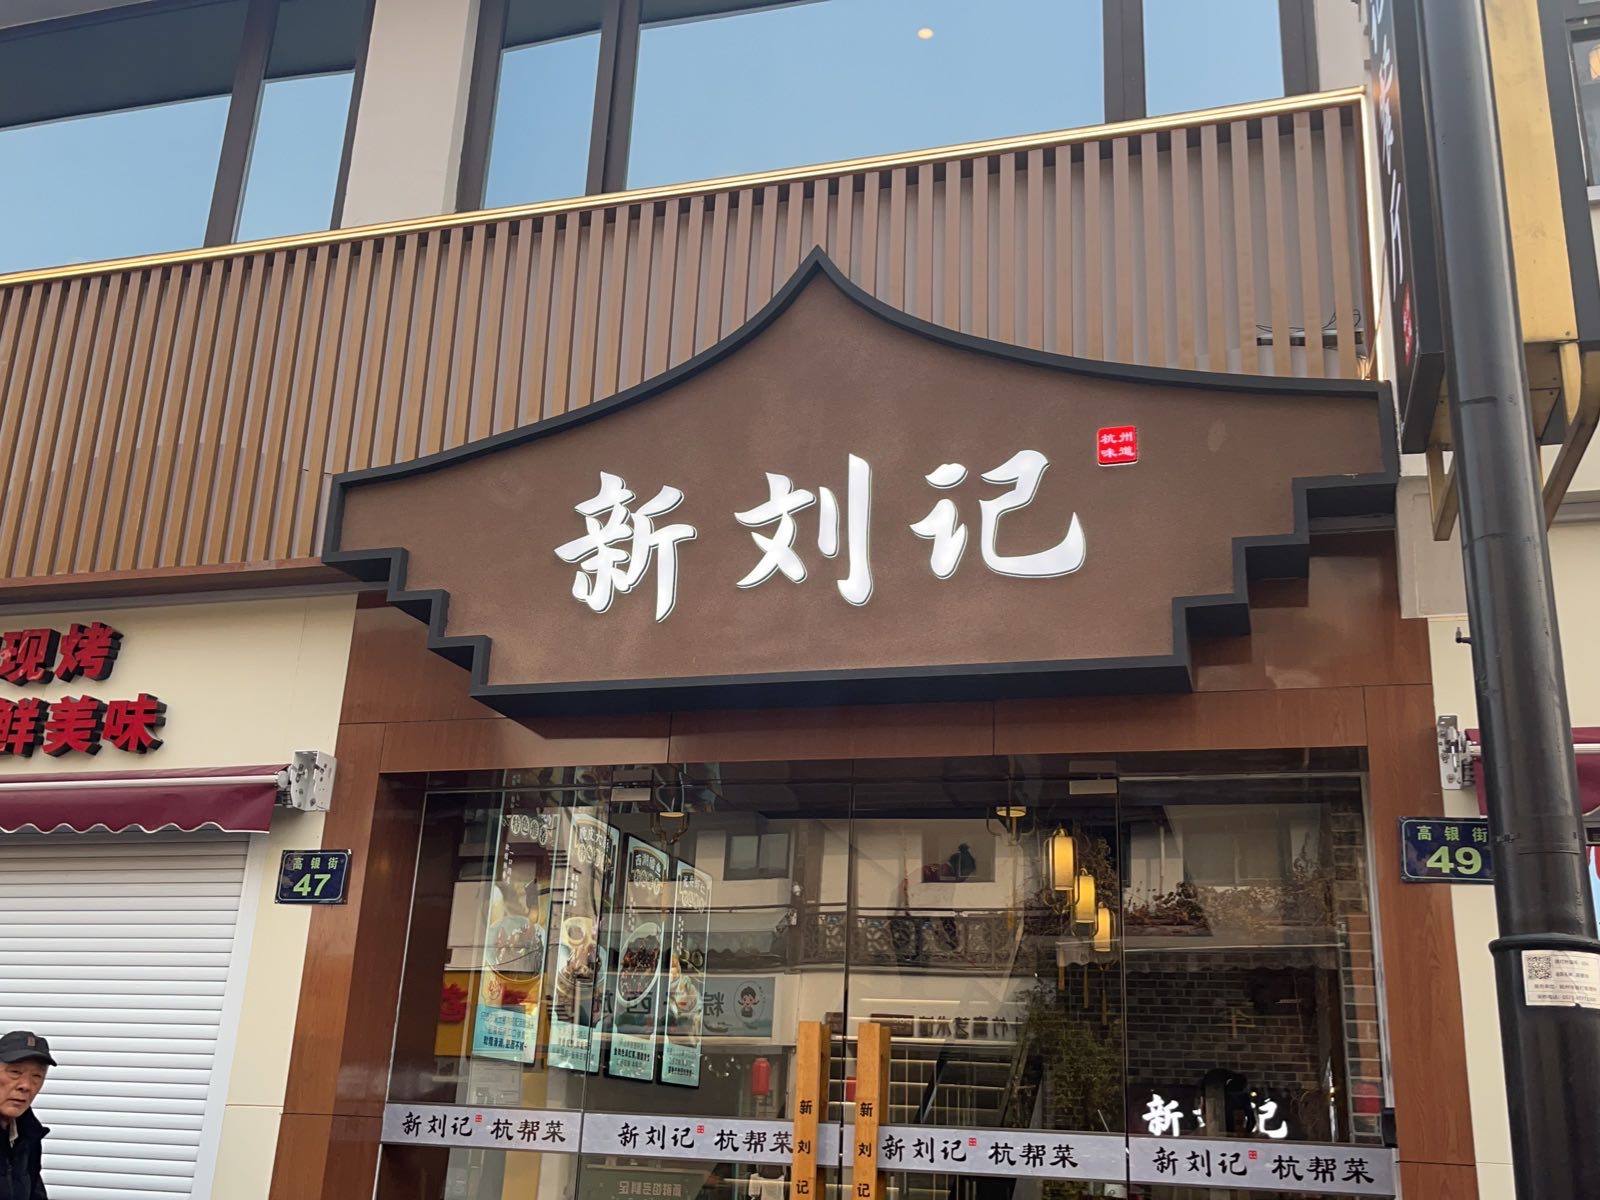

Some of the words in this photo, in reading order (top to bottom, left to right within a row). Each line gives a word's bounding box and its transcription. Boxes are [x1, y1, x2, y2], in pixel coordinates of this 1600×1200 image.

[1100, 431, 1134, 445] 杭州
[554, 450, 1086, 622] 新刘记
[0, 622, 120, 686] 现烤
[0, 693, 166, 757] 鲜美味
[1416, 825, 1488, 842] 高银街
[292, 856, 339, 871] 高银街
[1426, 846, 1482, 875] 49
[293, 874, 331, 897] 47
[402, 1111, 473, 1138] 新刘记
[490, 1118, 566, 1143] 杭帮菜
[1142, 1094, 1288, 1138] 新记
[618, 1122, 695, 1150] 新刘记
[714, 1129, 793, 1154] 杭帮菜
[796, 1100, 813, 1195] 新刘记
[857, 1102, 874, 1198] 新刘记
[882, 1134, 967, 1163] 新刘记
[988, 1142, 1078, 1168] 杭帮菜
[1152, 1147, 1248, 1177] 新刘记
[1272, 1155, 1375, 1184] 杭帮菜
